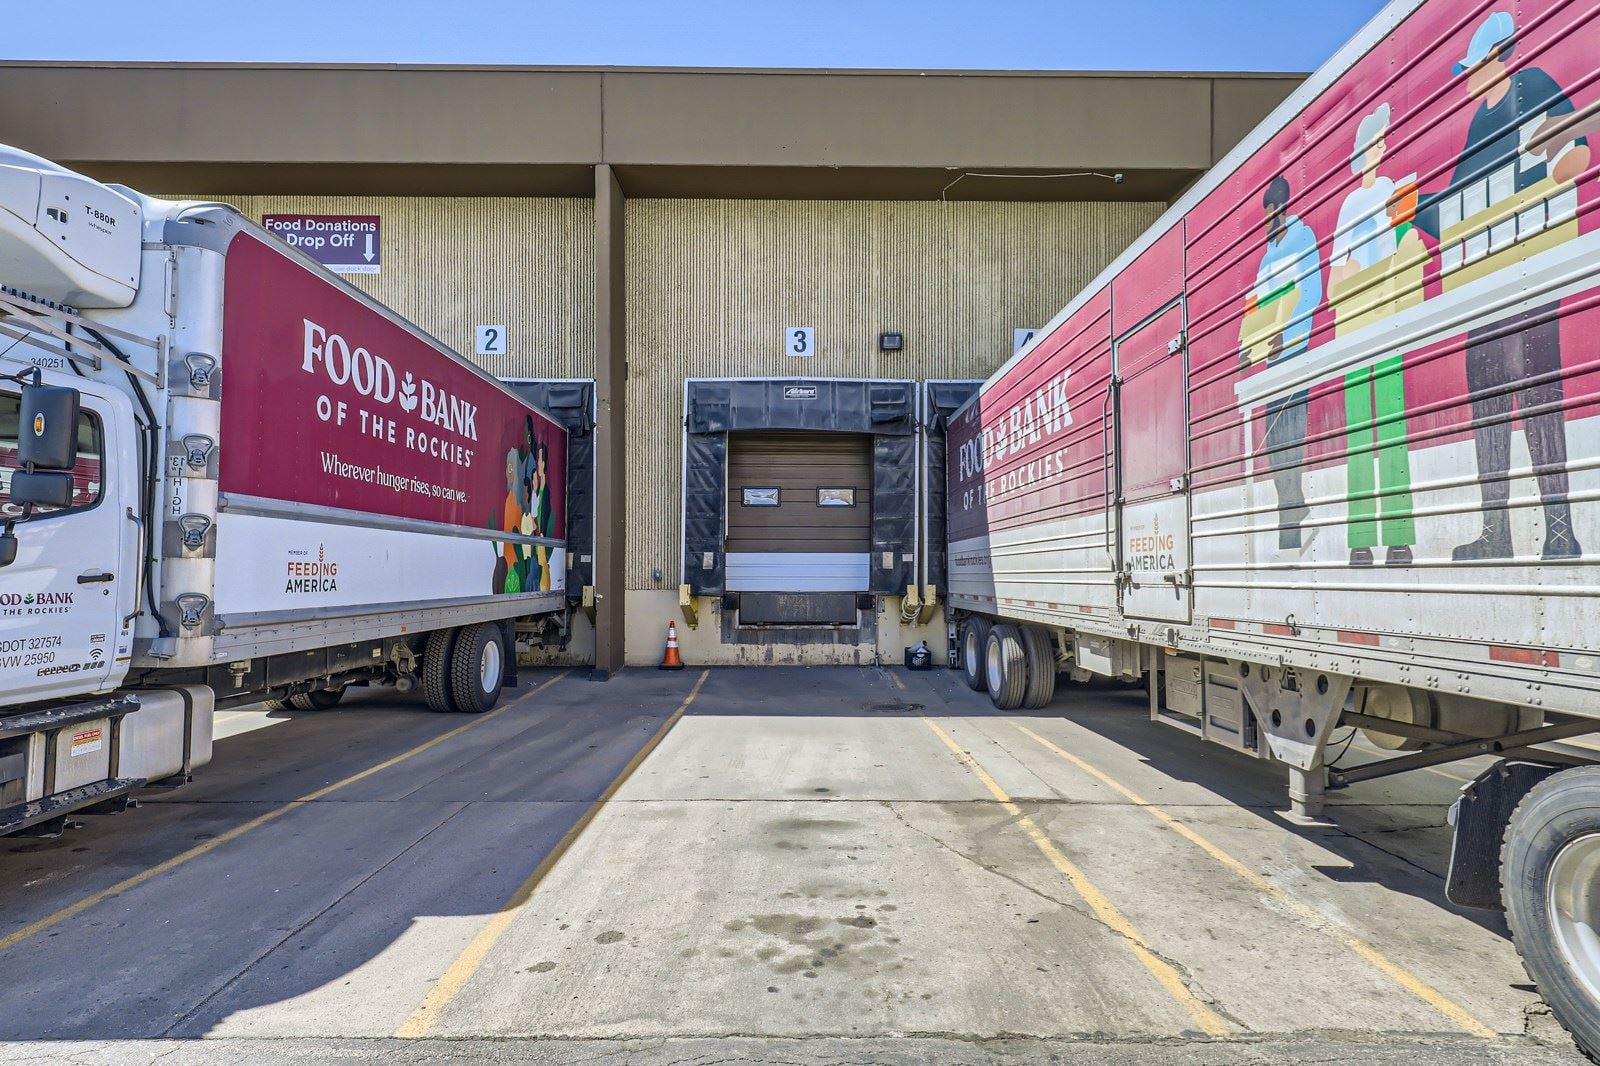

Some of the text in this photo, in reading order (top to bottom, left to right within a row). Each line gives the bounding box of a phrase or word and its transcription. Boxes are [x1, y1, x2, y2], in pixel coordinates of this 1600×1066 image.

[85, 205, 116, 227] T-880R
[265, 219, 377, 231] Food Donations
[286, 233, 354, 249] Drop Off
[485, 329, 498, 351] 2
[794, 330, 807, 353] 3
[302, 318, 478, 441] FOOD BANK
[316, 395, 347, 426] OF
[359, 409, 396, 444] THE
[960, 368, 1074, 482] FOOD BANK
[321, 451, 467, 503] Wherever hunger rises, so can we.
[963, 488, 975, 511] OF
[978, 480, 995, 506] THE
[1130, 534, 1174, 552] FEEDING
[287, 562, 337, 576] FEEDING
[1130, 553, 1175, 571] AMERICA
[285, 578, 337, 593] AMERICA
[0, 592, 74, 606] OD BANK
[3, 608, 22, 616] THE
[28, 636, 62, 650] 327574
[0, 655, 22, 669] VW
[24, 652, 55, 667] 25950
